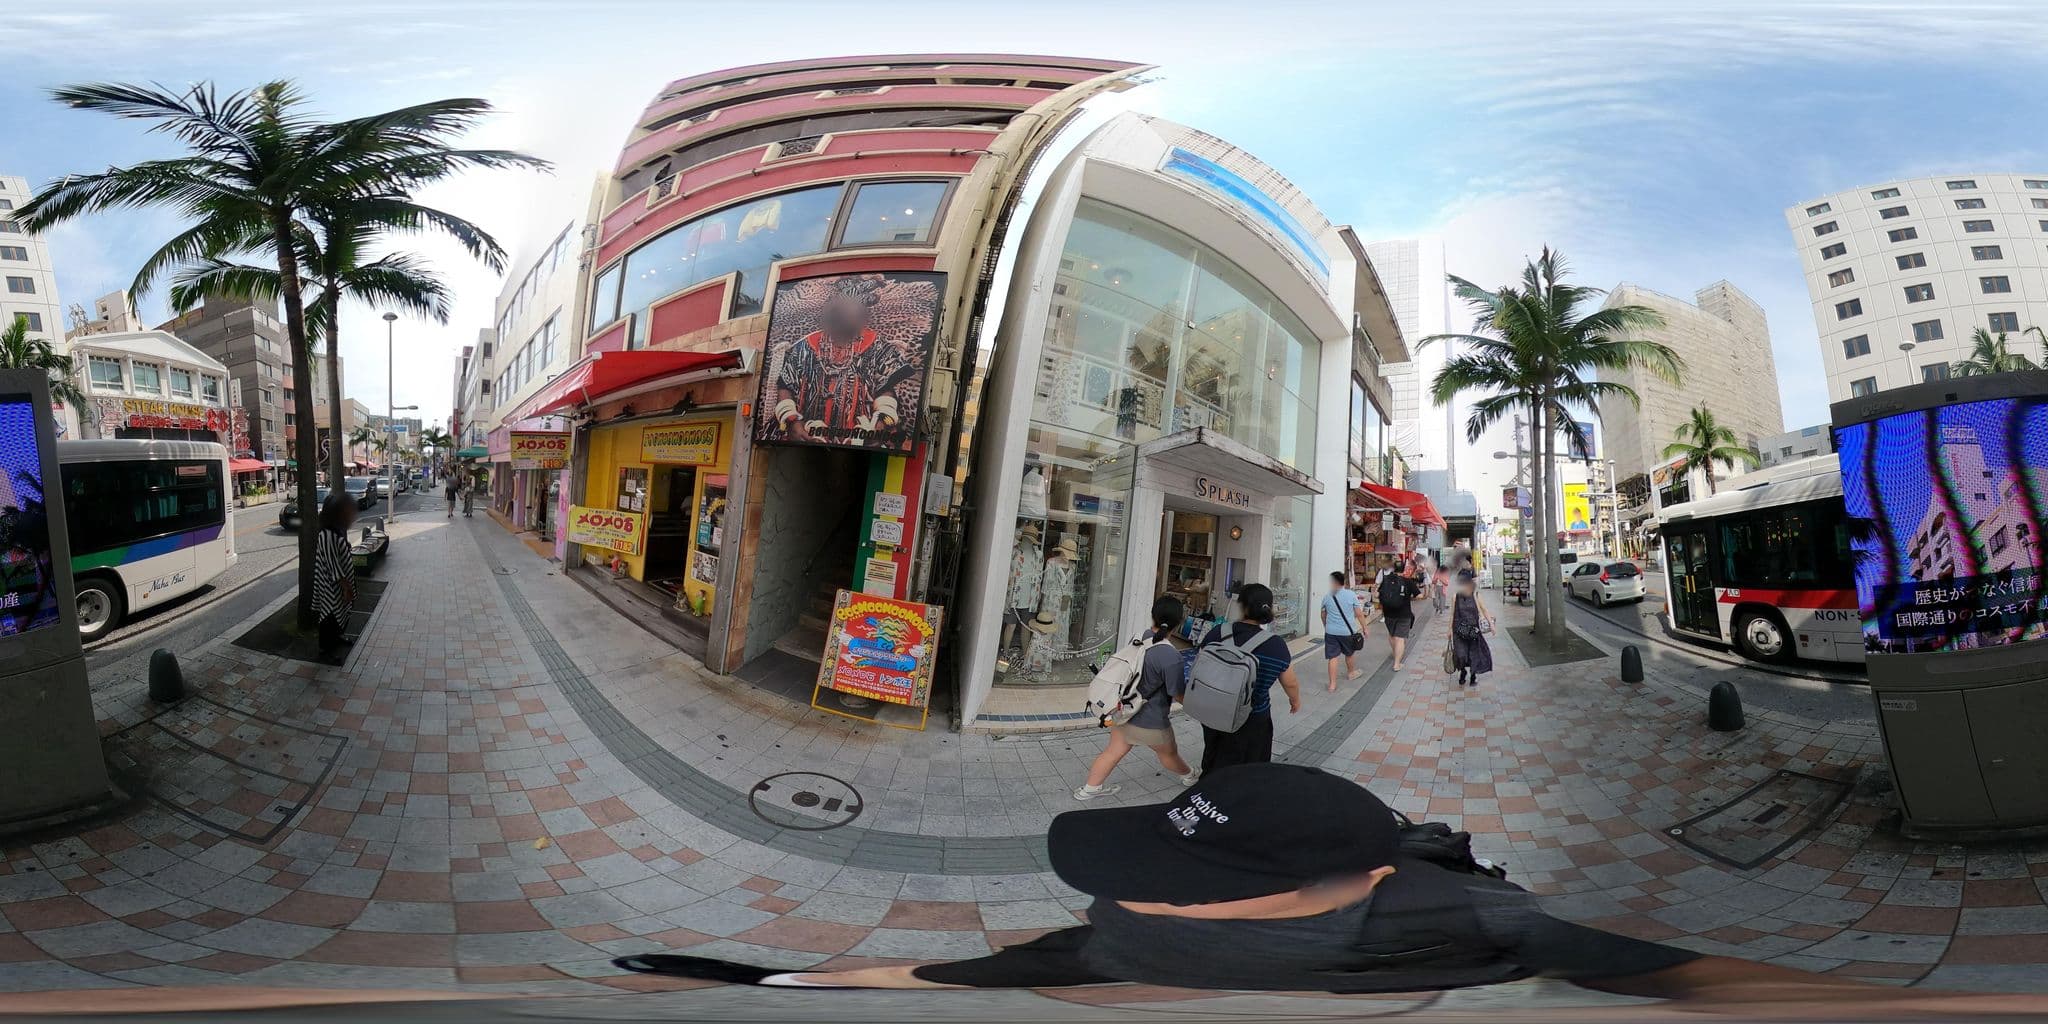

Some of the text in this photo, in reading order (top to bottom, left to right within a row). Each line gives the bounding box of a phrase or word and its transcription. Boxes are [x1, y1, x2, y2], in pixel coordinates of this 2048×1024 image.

[123, 399, 205, 418] STEAK HOUSE
[1198, 477, 1250, 508] SPLASH
[149, 572, 186, 592] Naha Bus
[1182, 806, 1200, 822] the
